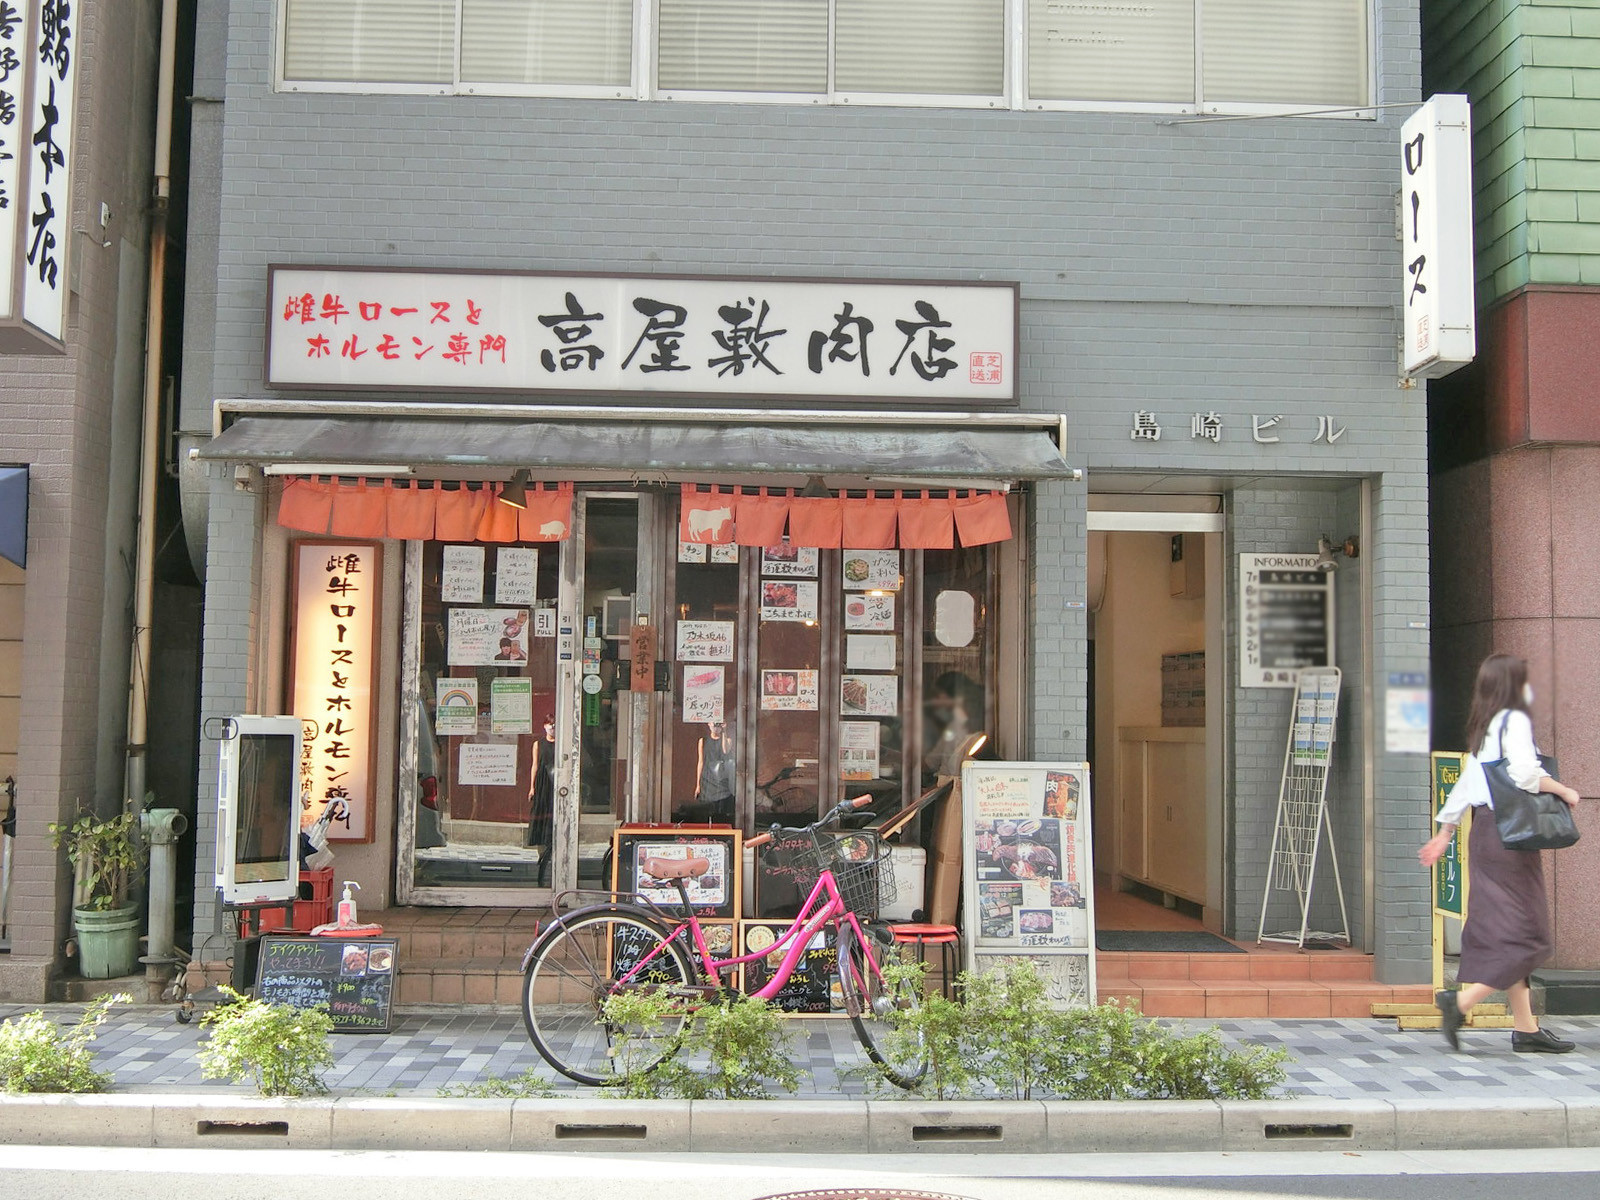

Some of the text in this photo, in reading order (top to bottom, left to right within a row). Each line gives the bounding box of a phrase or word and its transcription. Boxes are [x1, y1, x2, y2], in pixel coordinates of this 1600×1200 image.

[1404, 132, 1427, 307] ロース
[283, 292, 483, 326] 雌牛ロースと
[537, 291, 959, 382] 高屋敷肉店
[306, 332, 508, 366] ホルモン専門
[1130, 409, 1348, 444] 島崎ビル
[1254, 558, 1320, 567] INFORMATIO
[538, 614, 549, 629] 引
[562, 615, 571, 623] 引
[562, 641, 571, 649] 引
[635, 635, 650, 679] 営業中
[1046, 780, 1058, 793] 肉
[269, 943, 325, 957] テイクアウト
